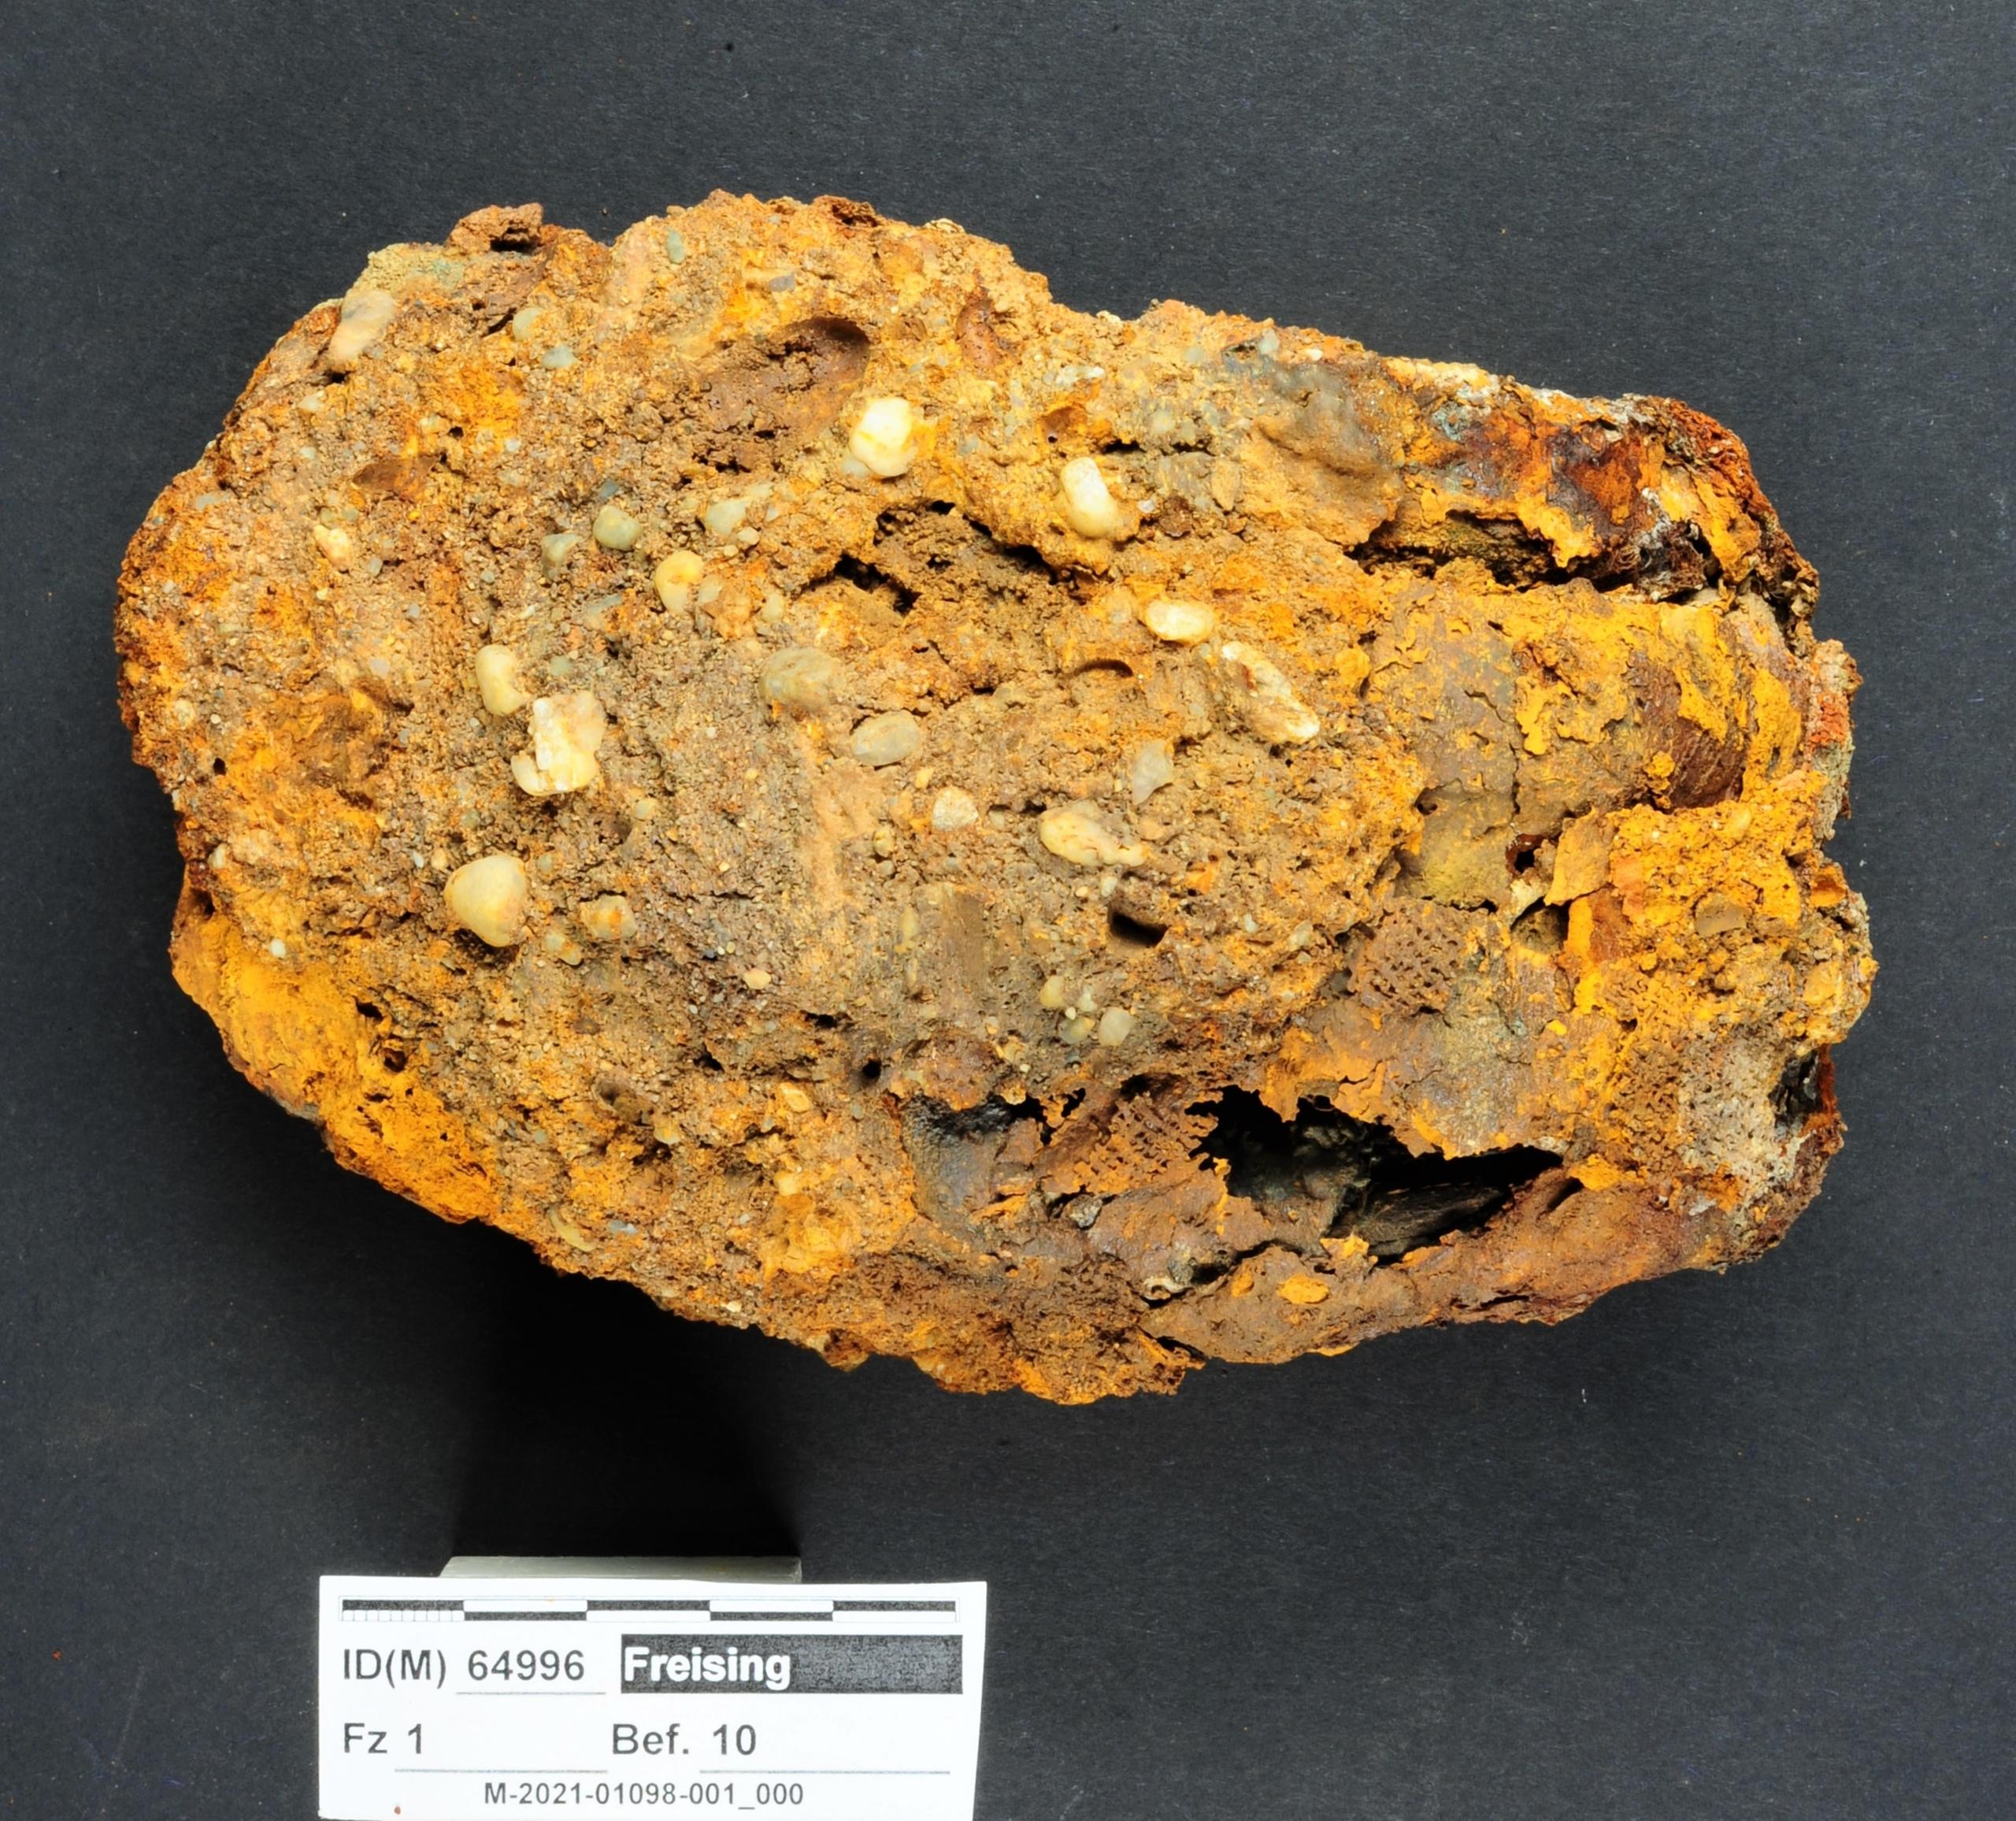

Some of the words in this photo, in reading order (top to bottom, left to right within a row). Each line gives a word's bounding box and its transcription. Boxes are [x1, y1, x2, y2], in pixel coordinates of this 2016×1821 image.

[344, 1649, 446, 1688] ID(M)
[468, 1650, 584, 1681] 64996
[624, 1646, 791, 1689] Freising
[344, 1723, 387, 1753] Fz
[408, 1723, 421, 1754] 1
[613, 1723, 688, 1755] Bef.
[713, 1724, 756, 1756] 10
[485, 1782, 804, 1809] M-2021-01098-001_000
